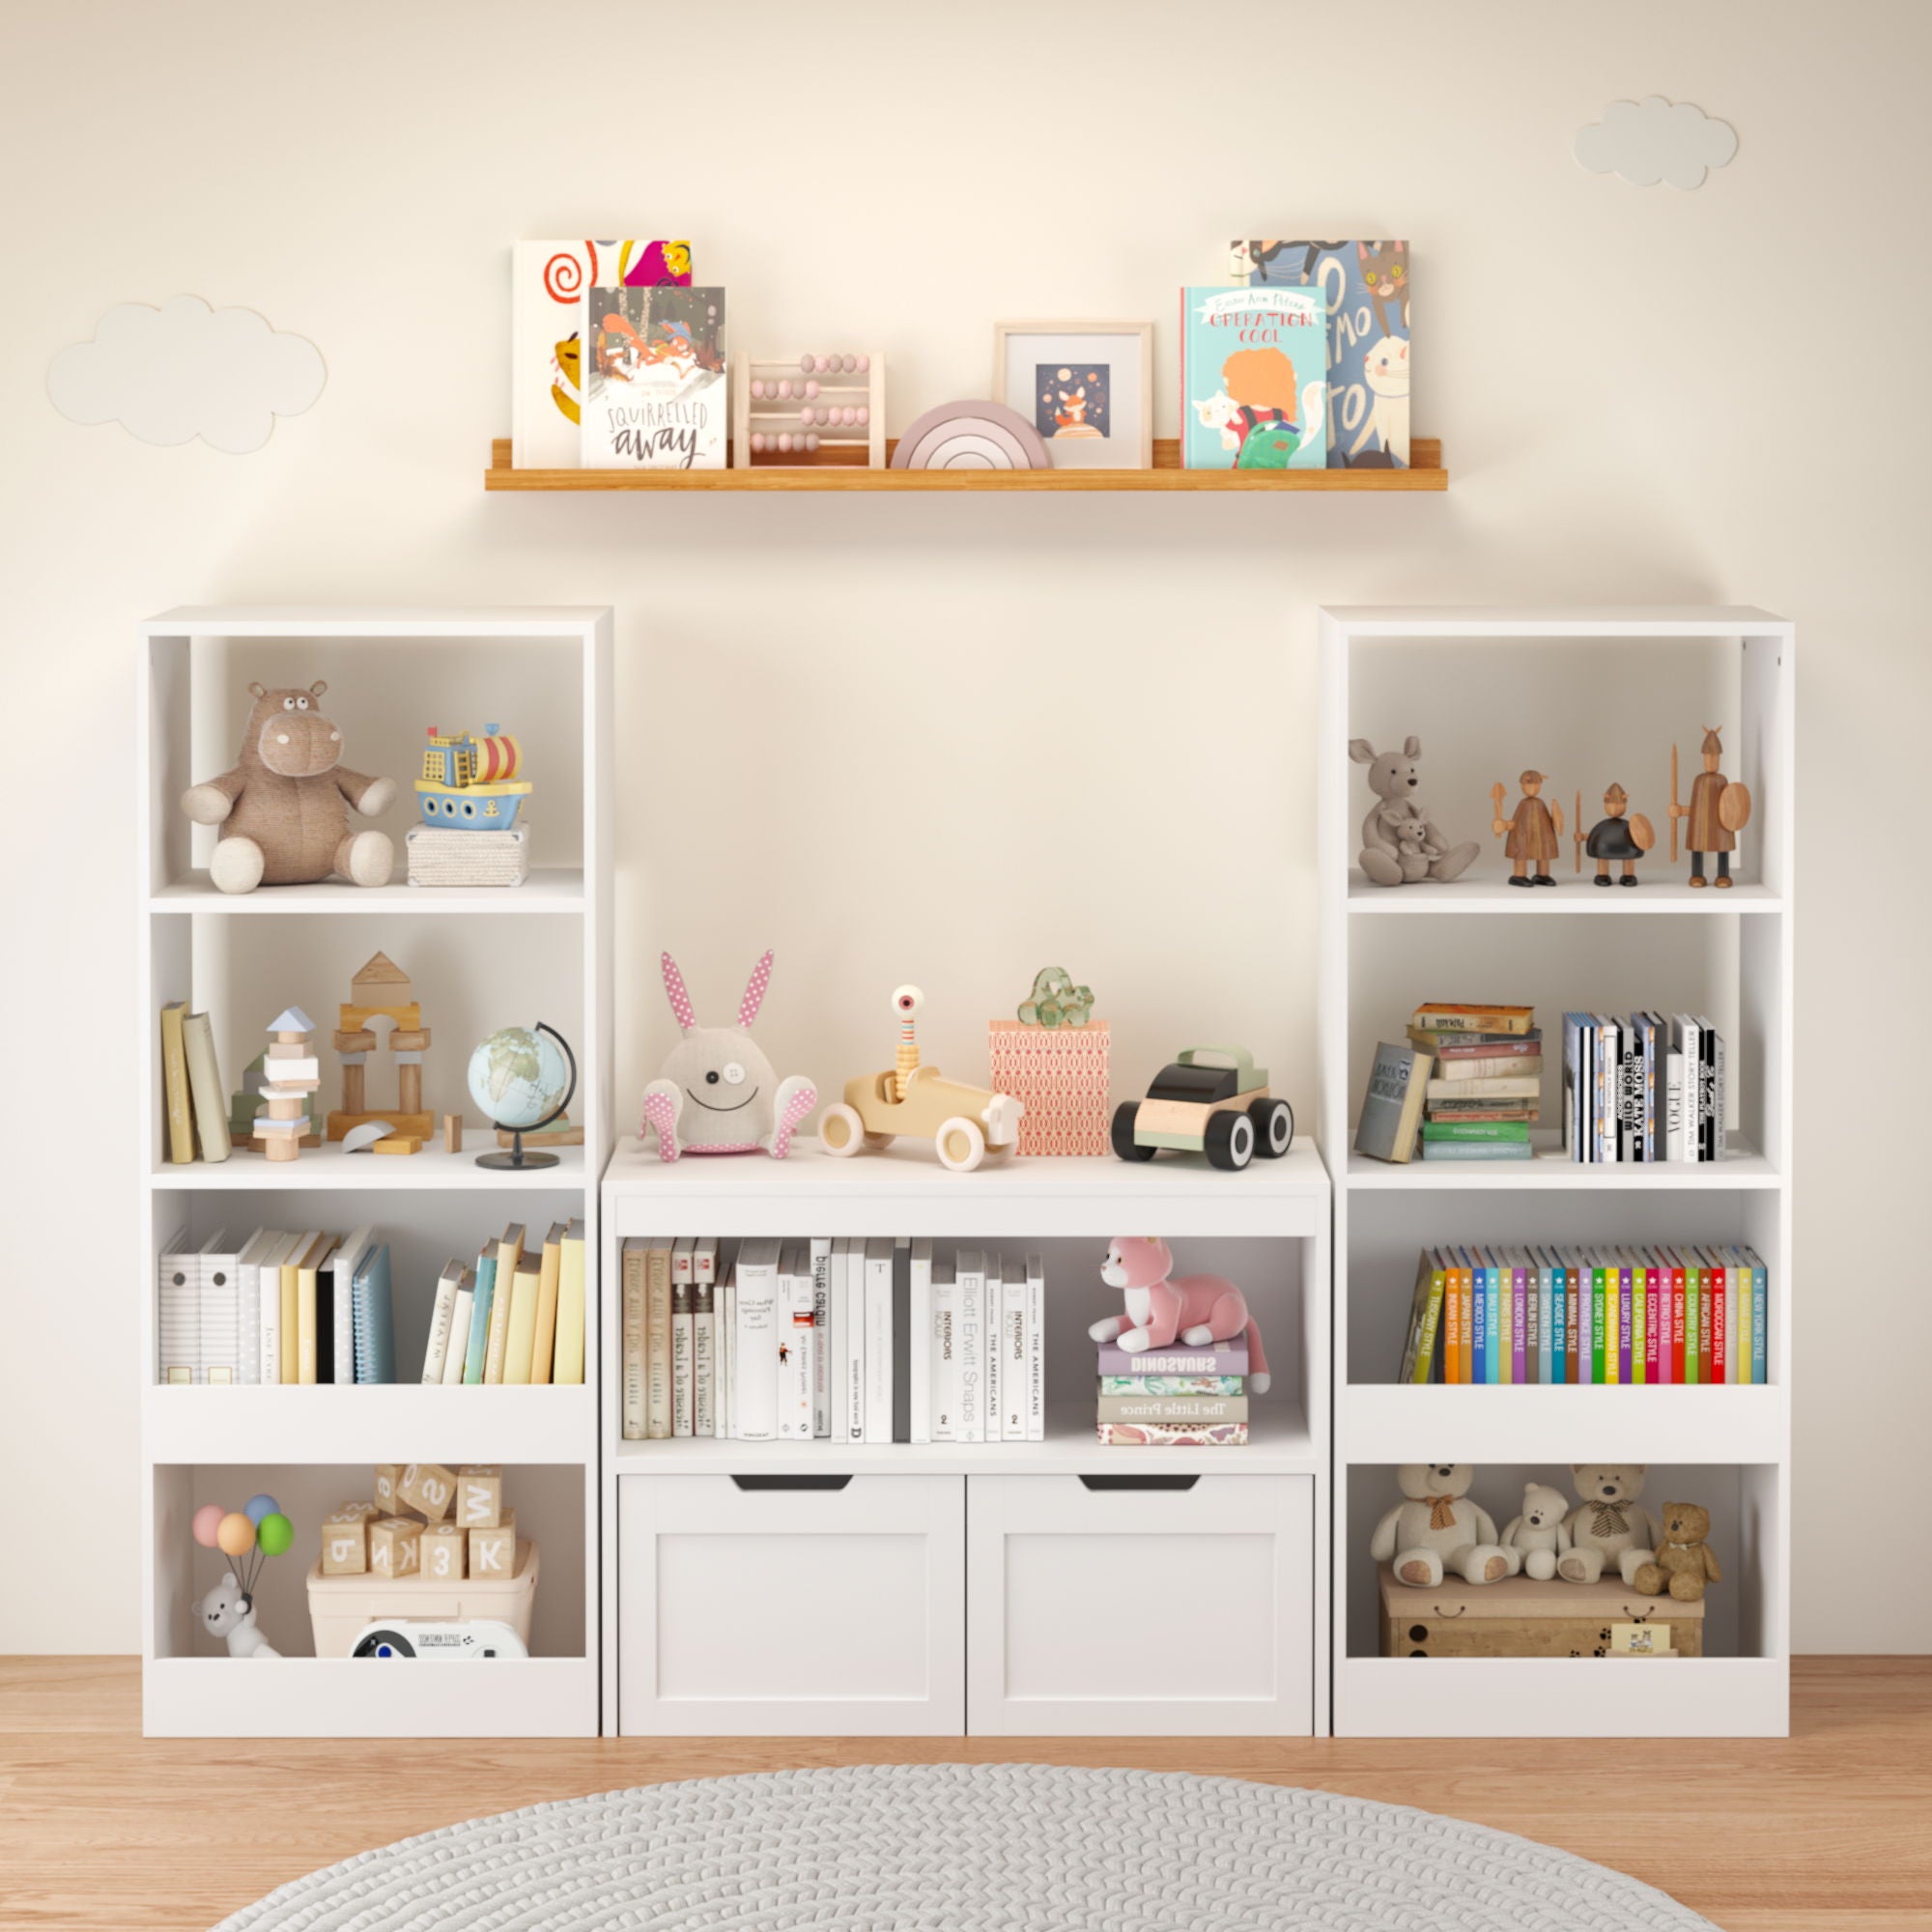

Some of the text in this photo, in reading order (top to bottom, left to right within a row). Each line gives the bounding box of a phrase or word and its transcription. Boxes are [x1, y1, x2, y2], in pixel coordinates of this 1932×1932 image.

[1209, 313, 1313, 327] OPERATION
[1238, 329, 1283, 343] COOL
[608, 401, 707, 433] SQUIRRELLED
[611, 427, 706, 469] away
[1634, 1056, 1644, 1095] MOSS
[1634, 1098, 1644, 1137] KATE
[1668, 1082, 1681, 1133] VOGUE
[943, 1311, 952, 1360] INTERIORS
[1448, 1321, 1458, 1345] STYLE
[1461, 1293, 1470, 1345] JAPAN STYLE
[1475, 1293, 1484, 1350] MEXICO STYLE
[1488, 1312, 1497, 1337] STYLE
[1515, 1293, 1523, 1352] LONDON STYLE
[1527, 1293, 1537, 1348] BERLIN STYLE
[1554, 1293, 1563, 1352] SEASIDE STYLE
[1568, 1293, 1577, 1353] MINIMAL STYLE
[1594, 1293, 1604, 1350] SYDNEY STYLE
[1621, 1293, 1631, 1350] LUXURY STYLE
[1647, 1293, 1657, 1362] ECCENTRIC STYLE
[1661, 1293, 1670, 1345] RETRO STYLE
[1674, 1293, 1684, 1344] CHINA STYLE
[1700, 1293, 1710, 1353] AFRICAN STYLE
[1714, 1293, 1723, 1366] MOROCCAN STYLE
[961, 1277, 978, 1422] Elliott Erwitt Snaps
[1421, 1332, 1434, 1357] STYLE
[1581, 1336, 1590, 1360] STYLE
[1634, 1341, 1643, 1365] STYLE
[1688, 1332, 1697, 1356] STYLE
[1753, 1336, 1763, 1360] STYLE
[851, 1428, 862, 1438] D
[479, 1541, 502, 1571] K
